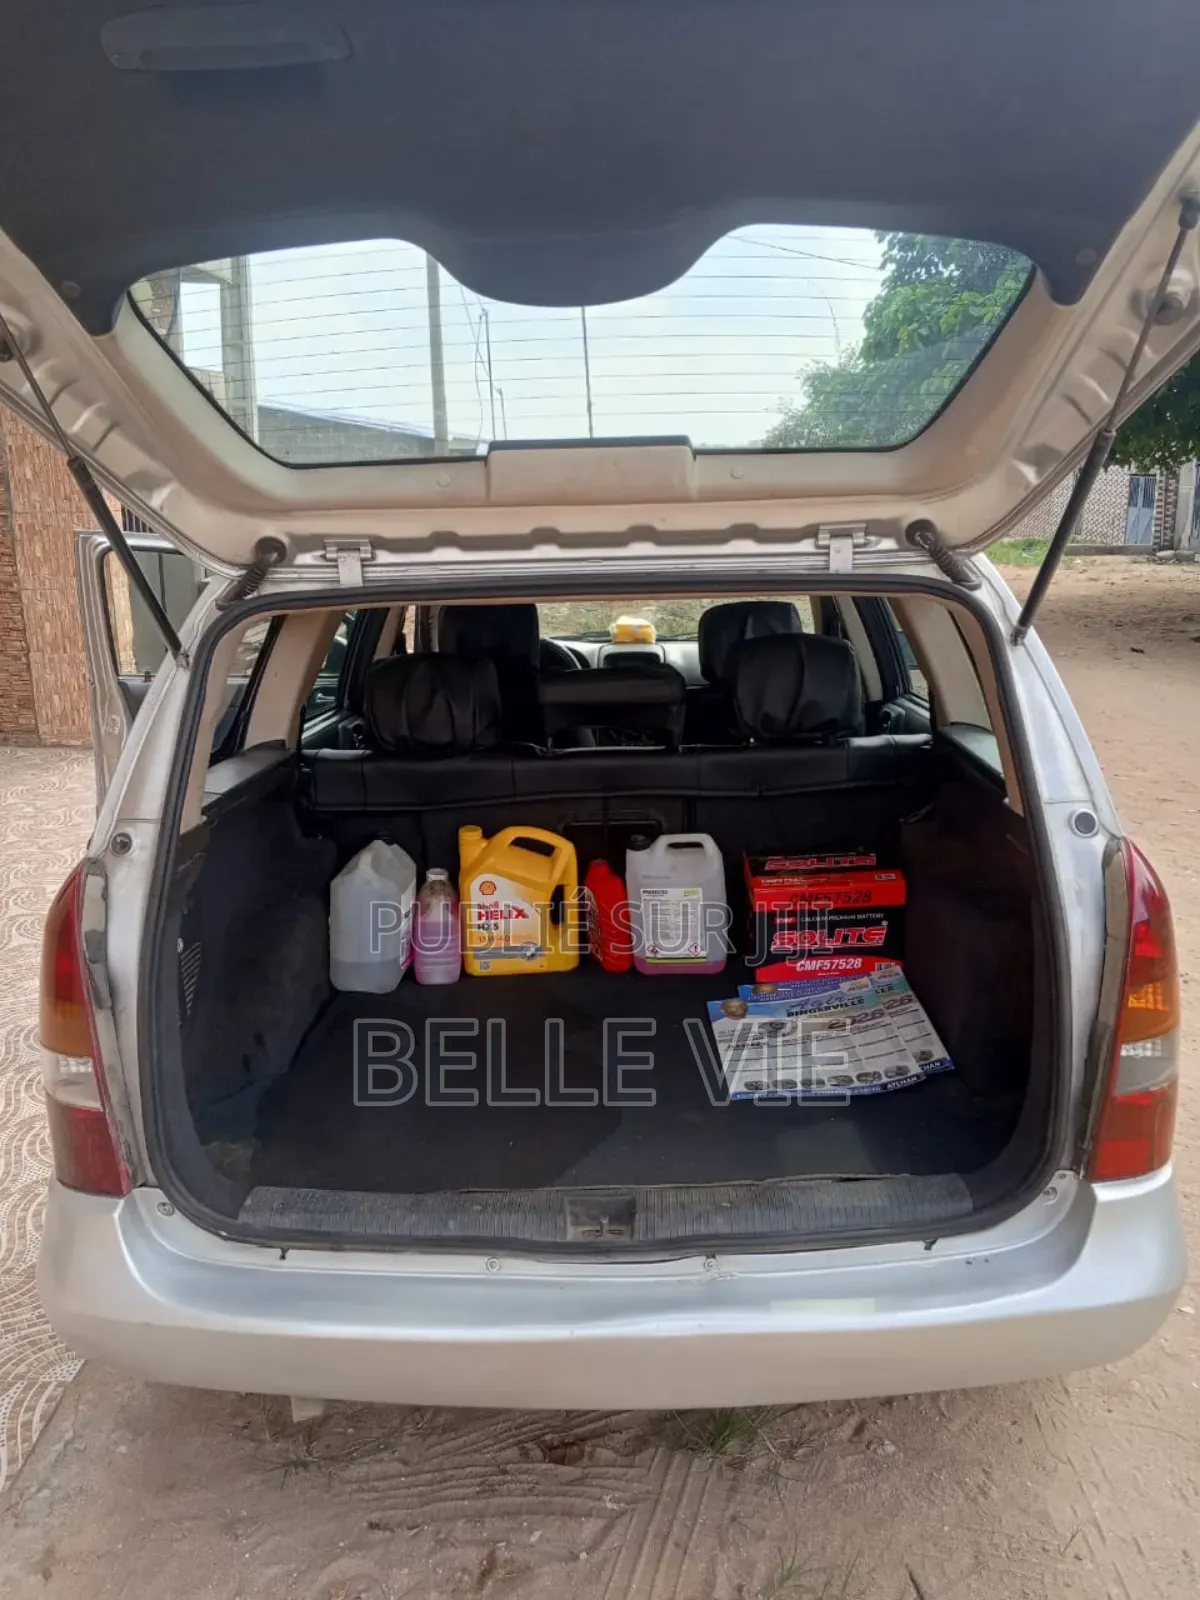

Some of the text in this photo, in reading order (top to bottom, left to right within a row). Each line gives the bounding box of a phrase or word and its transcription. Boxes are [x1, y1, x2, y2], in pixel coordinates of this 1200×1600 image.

[477, 905, 530, 921] HELIX
[771, 926, 888, 952] SOLITE
[796, 958, 863, 972] CMF57528
